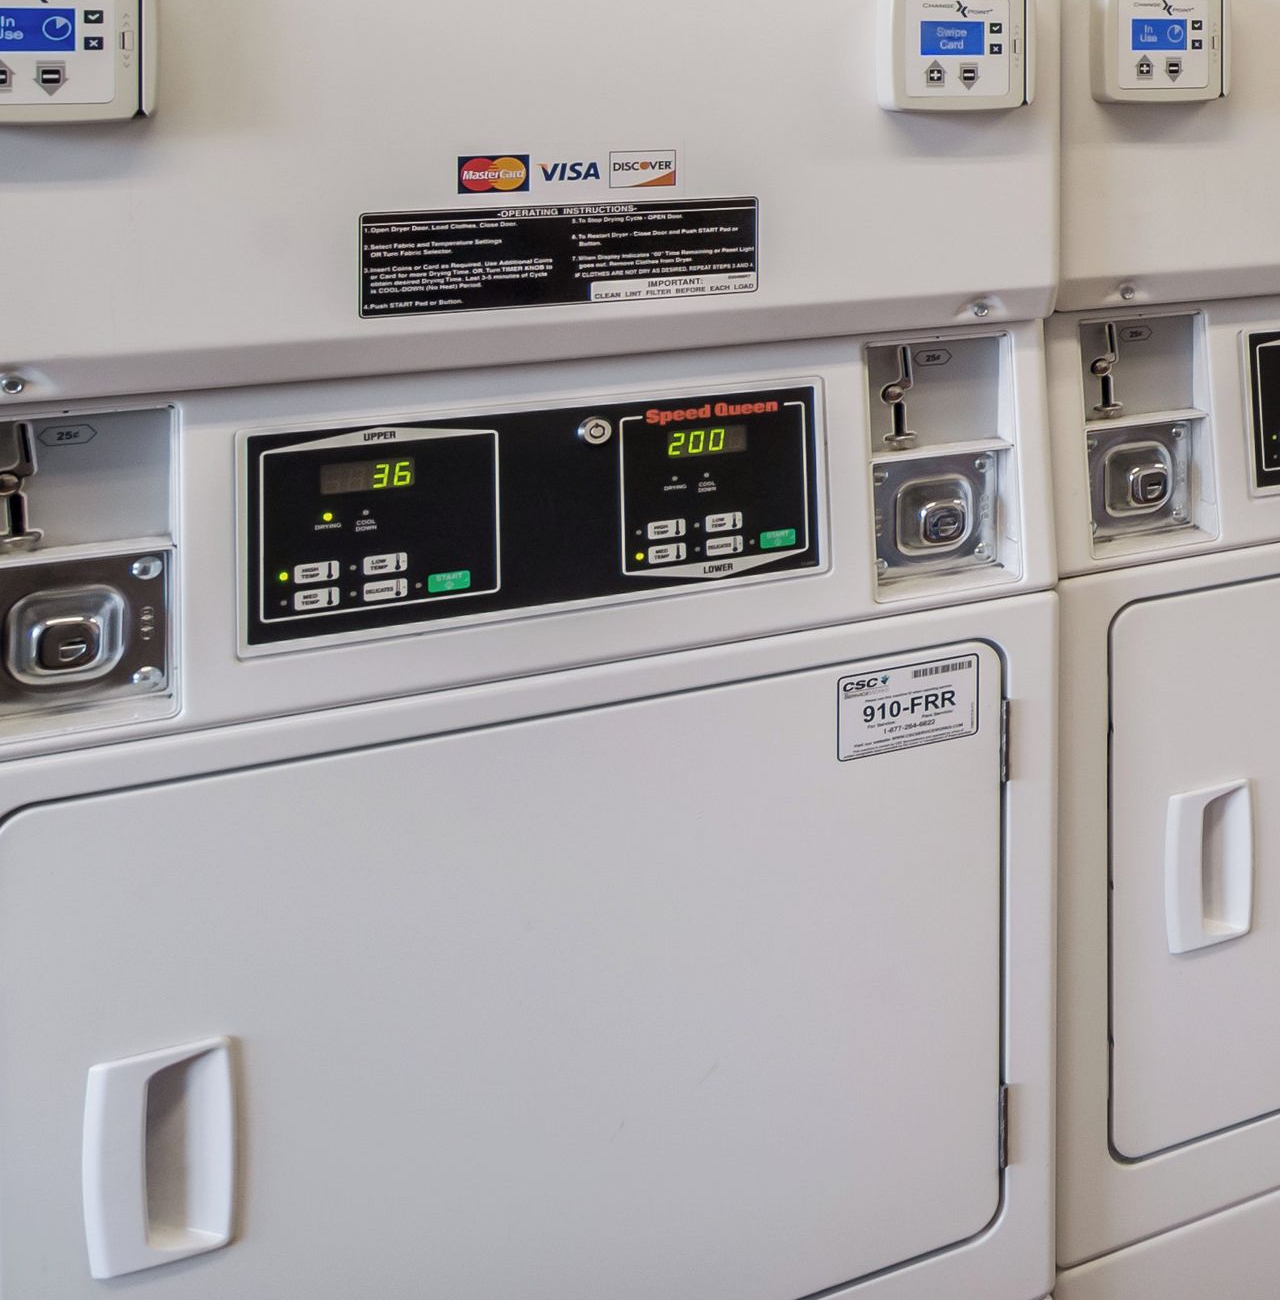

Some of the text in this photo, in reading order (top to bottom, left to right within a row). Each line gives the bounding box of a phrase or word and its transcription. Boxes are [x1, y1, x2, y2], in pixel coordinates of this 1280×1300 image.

[1, 16, 15, 27] In
[936, 26, 967, 39] Swipe
[1144, 24, 1153, 33] In
[1140, 34, 1158, 43] Use
[940, 40, 964, 50] Card
[462, 160, 672, 181] MasterCard VISA DISCOVER
[648, 278, 704, 288] IMPORTANT:
[646, 401, 778, 426] Speed Queen
[56, 431, 79, 441] 25¢
[364, 431, 396, 442] UPPER
[668, 429, 725, 456] 200
[373, 461, 412, 489] 36
[314, 522, 342, 531] DRYING
[704, 563, 733, 574] LOWER
[436, 572, 463, 582] START
[843, 678, 878, 692] CSC
[863, 690, 956, 723] 910-FRR
